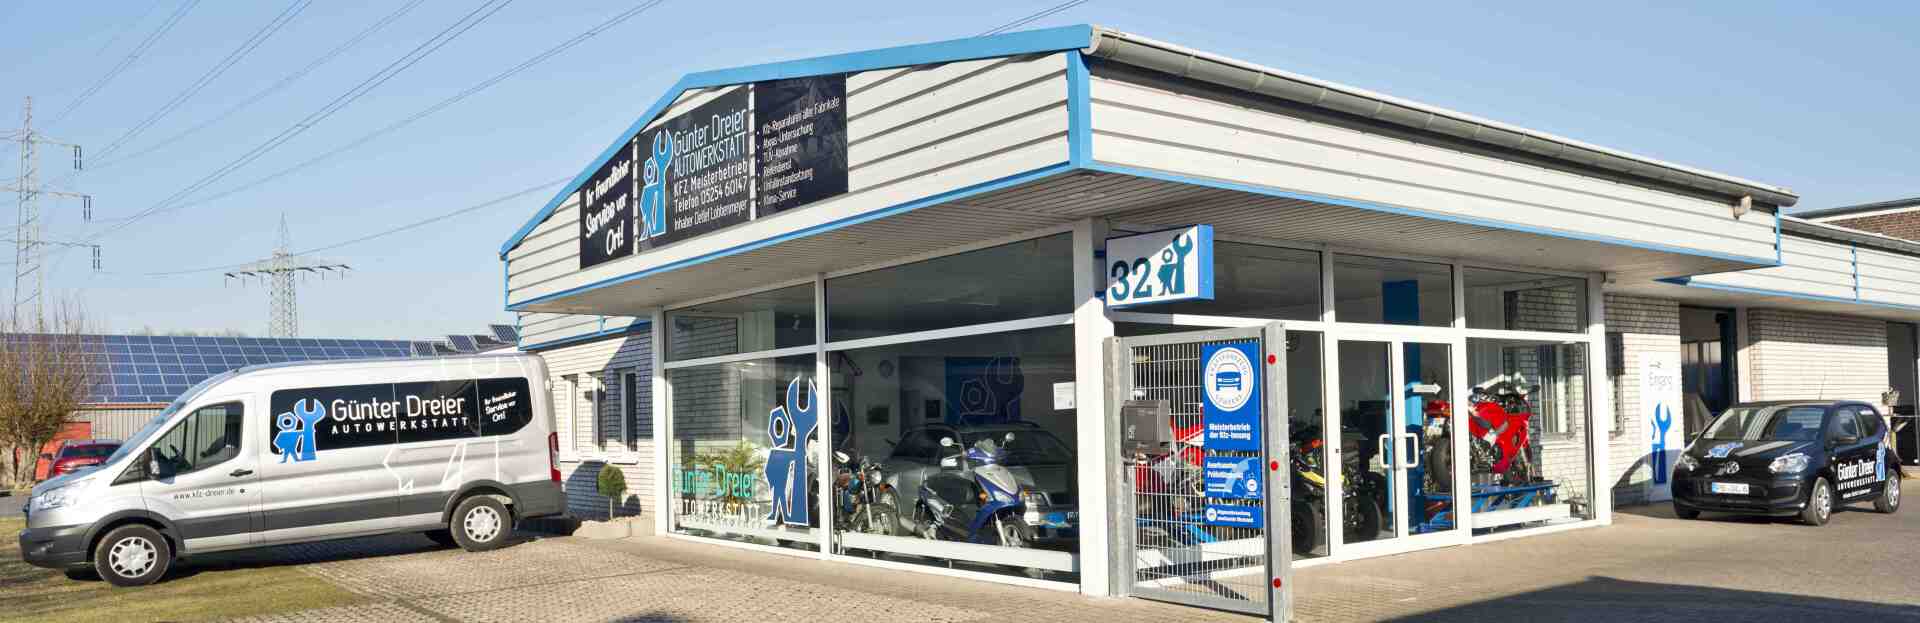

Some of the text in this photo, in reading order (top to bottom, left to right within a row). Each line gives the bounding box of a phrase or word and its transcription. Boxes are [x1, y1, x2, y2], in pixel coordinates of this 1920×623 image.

[815, 96, 840, 114] Fabrikate
[674, 108, 747, 156] Günter Dreier
[674, 131, 747, 178] AUTOWERKSTATT
[674, 158, 747, 197] KFZ Meisterbetrieb
[674, 176, 748, 213] Telefon 05254 60147
[763, 189, 797, 206] Klima-Service
[586, 193, 627, 238] Service vor
[674, 216, 693, 231] Inhaber
[606, 219, 624, 255] Ort!
[1111, 257, 1153, 301] 32
[331, 395, 465, 422] Günter Dreier
[485, 403, 508, 415] Service
[492, 410, 506, 422] Ort!
[331, 416, 469, 435] AUTOWERKSTATT
[714, 464, 756, 497] Dreier
[1838, 459, 1876, 481] Günter Dreier
